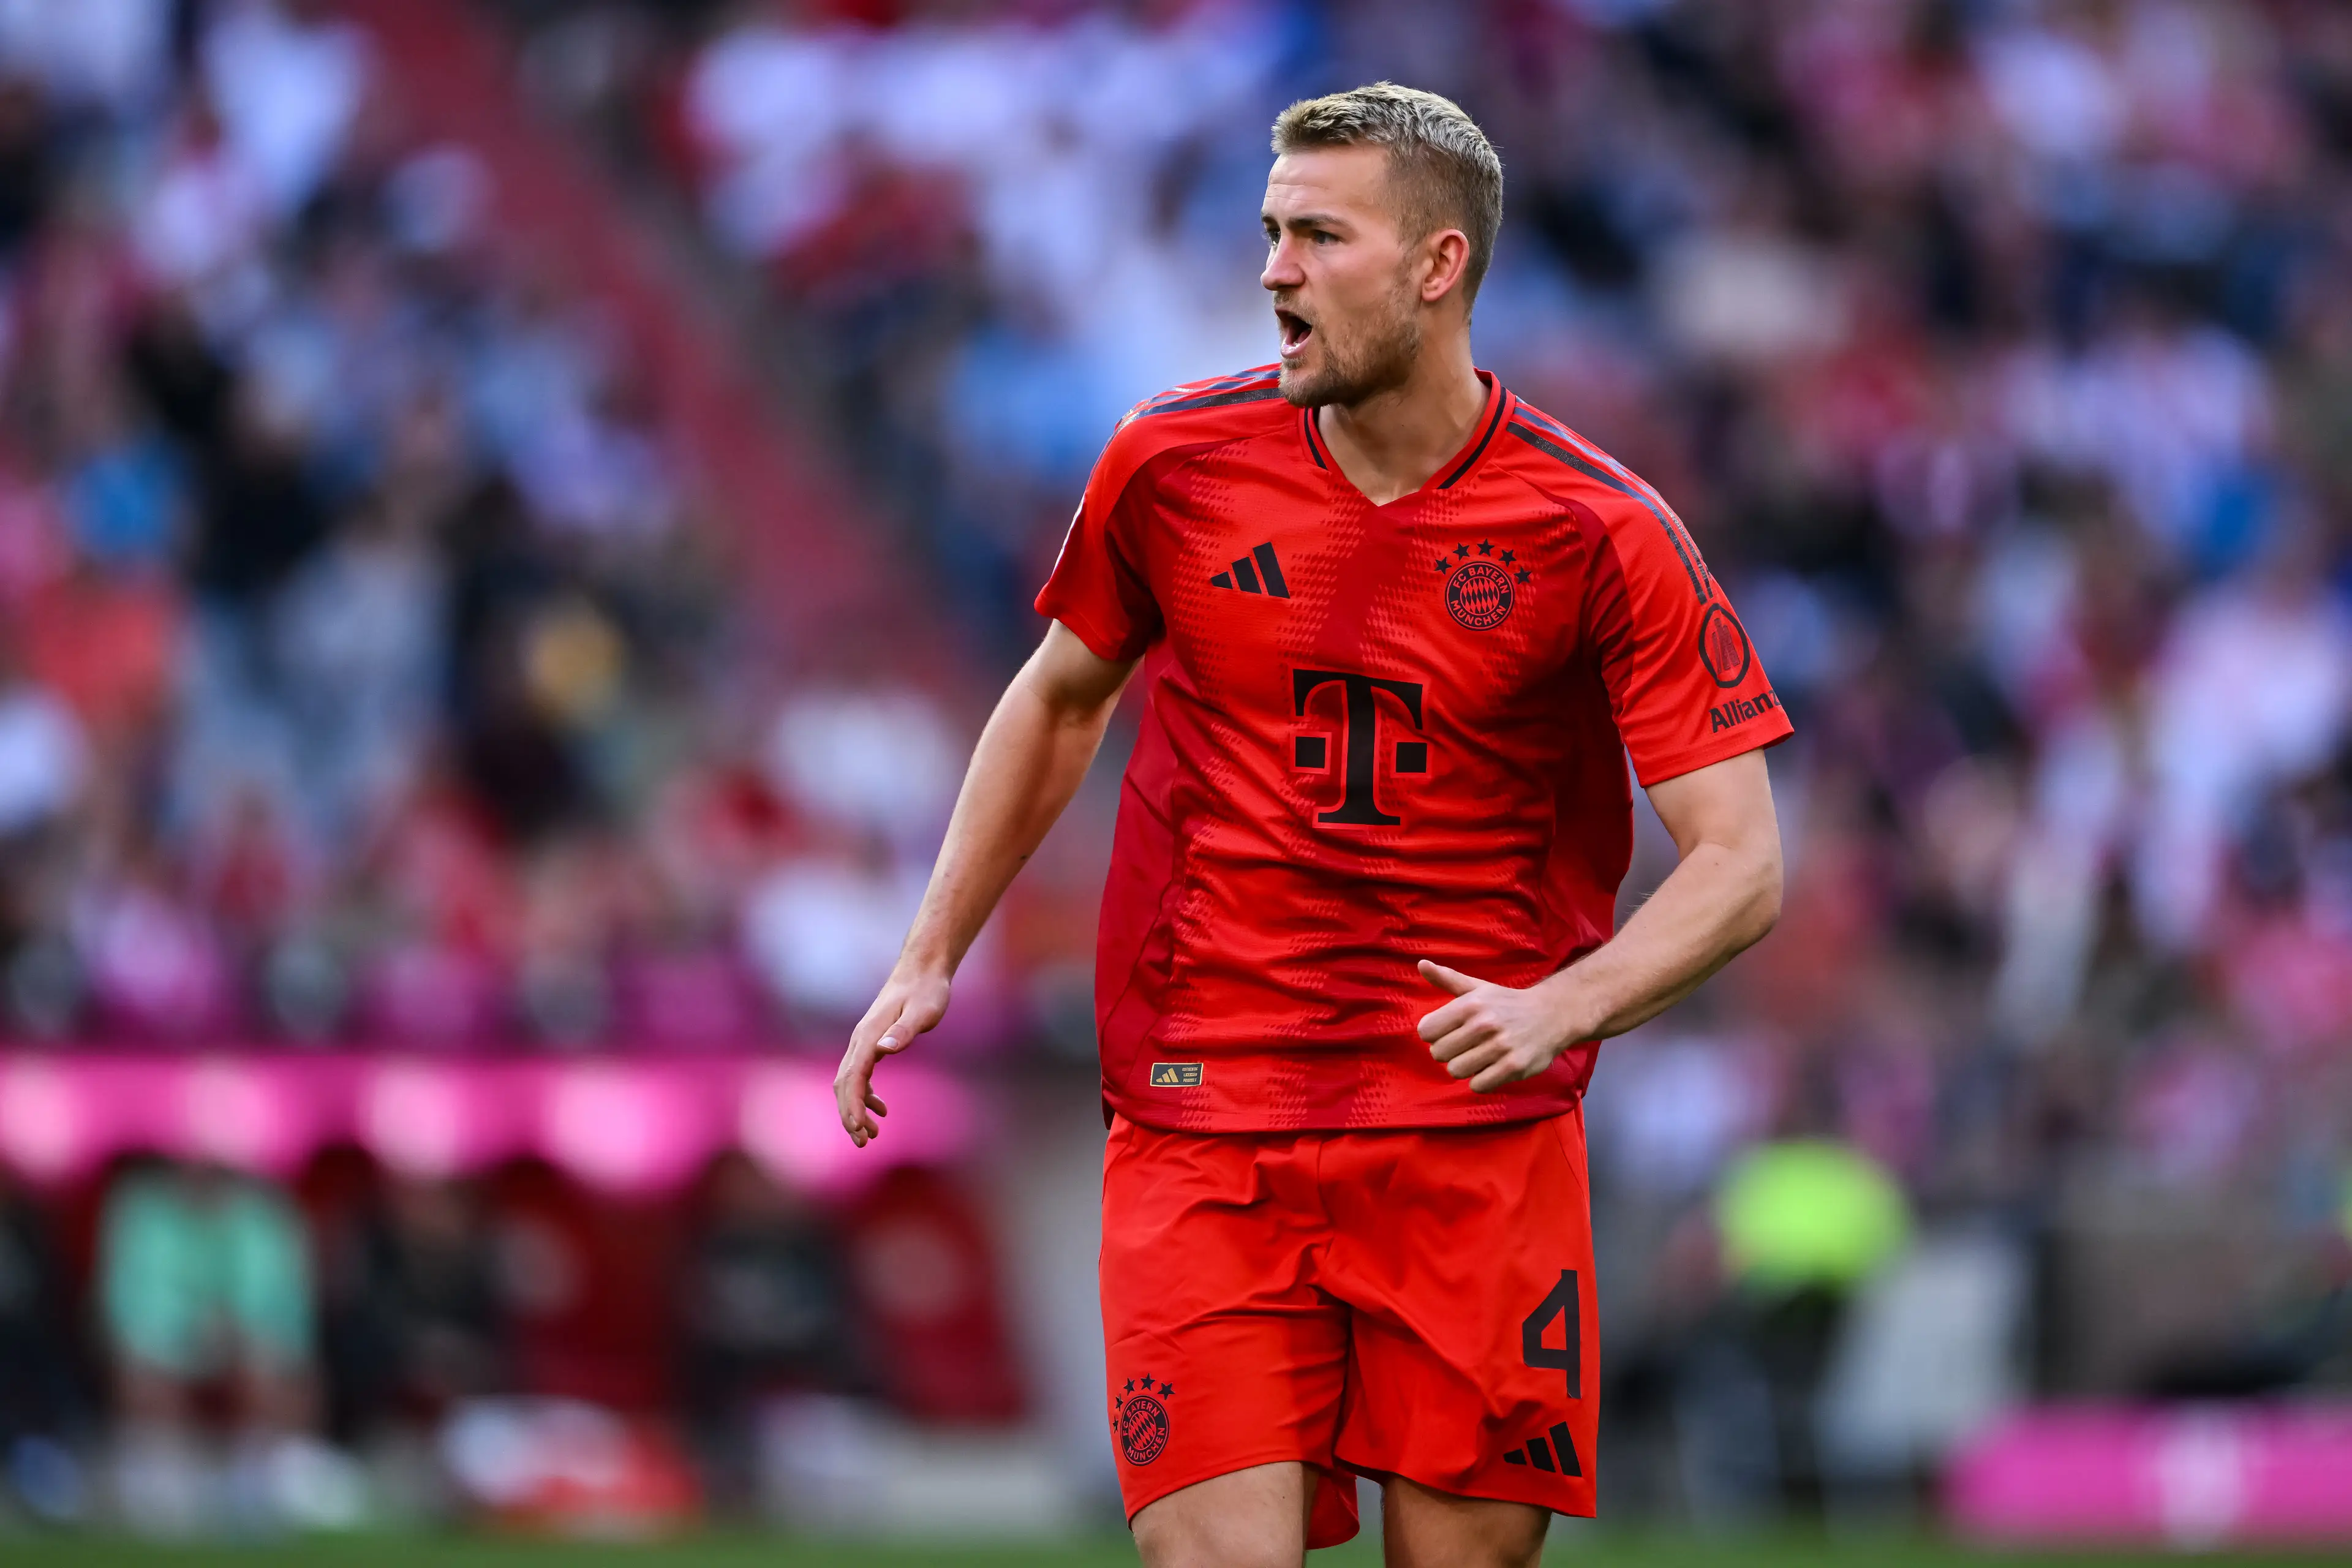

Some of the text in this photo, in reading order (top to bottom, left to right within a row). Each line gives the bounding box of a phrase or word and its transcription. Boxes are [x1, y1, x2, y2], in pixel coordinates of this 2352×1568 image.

[1453, 566, 1509, 594] FC BAYERN
[1450, 600, 1507, 626] MÜNCHEN
[1293, 669, 1423, 826] T
[1522, 1268, 1582, 1399] 4
[1123, 1401, 1160, 1436] FC BAYERN
